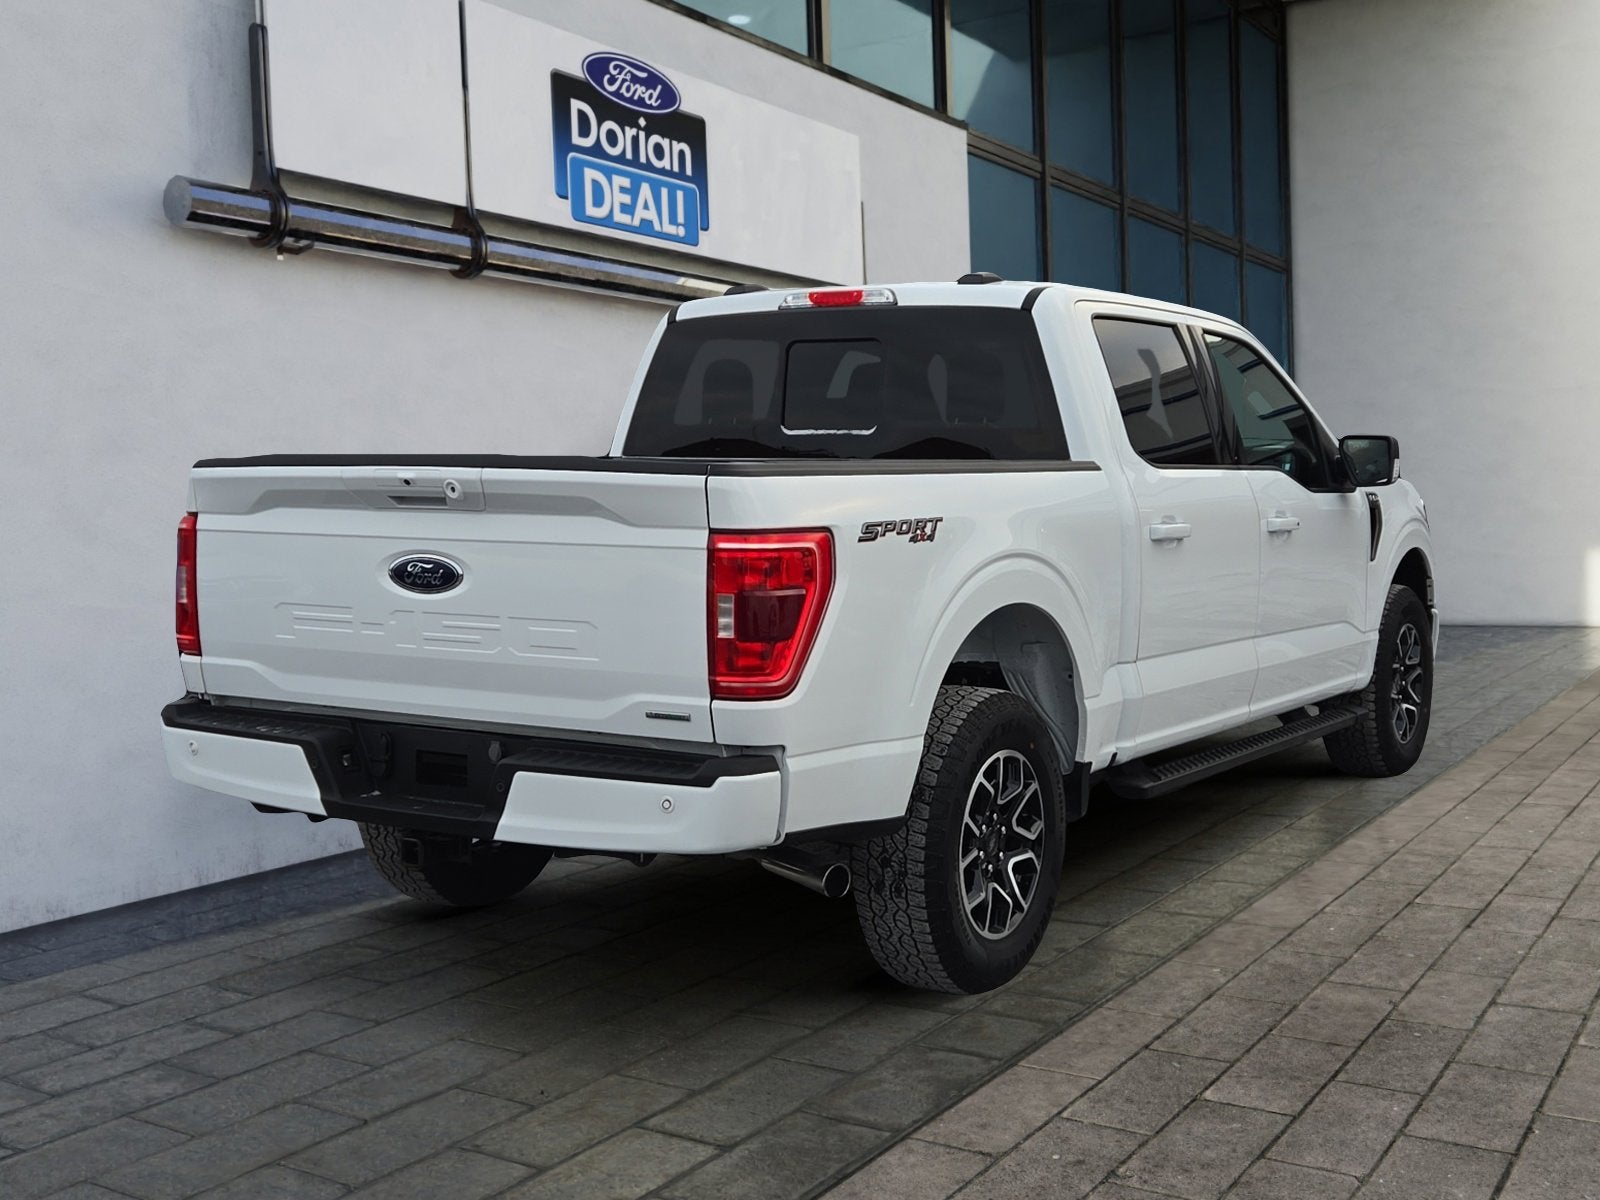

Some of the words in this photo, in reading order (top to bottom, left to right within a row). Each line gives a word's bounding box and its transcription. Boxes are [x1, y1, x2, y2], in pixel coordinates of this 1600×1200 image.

[603, 60, 662, 107] Ford
[570, 97, 692, 177] Dorian
[583, 167, 686, 238] DEAL!
[857, 517, 944, 543] SPORT
[404, 561, 444, 585] Ford
[274, 602, 600, 661] F-150
